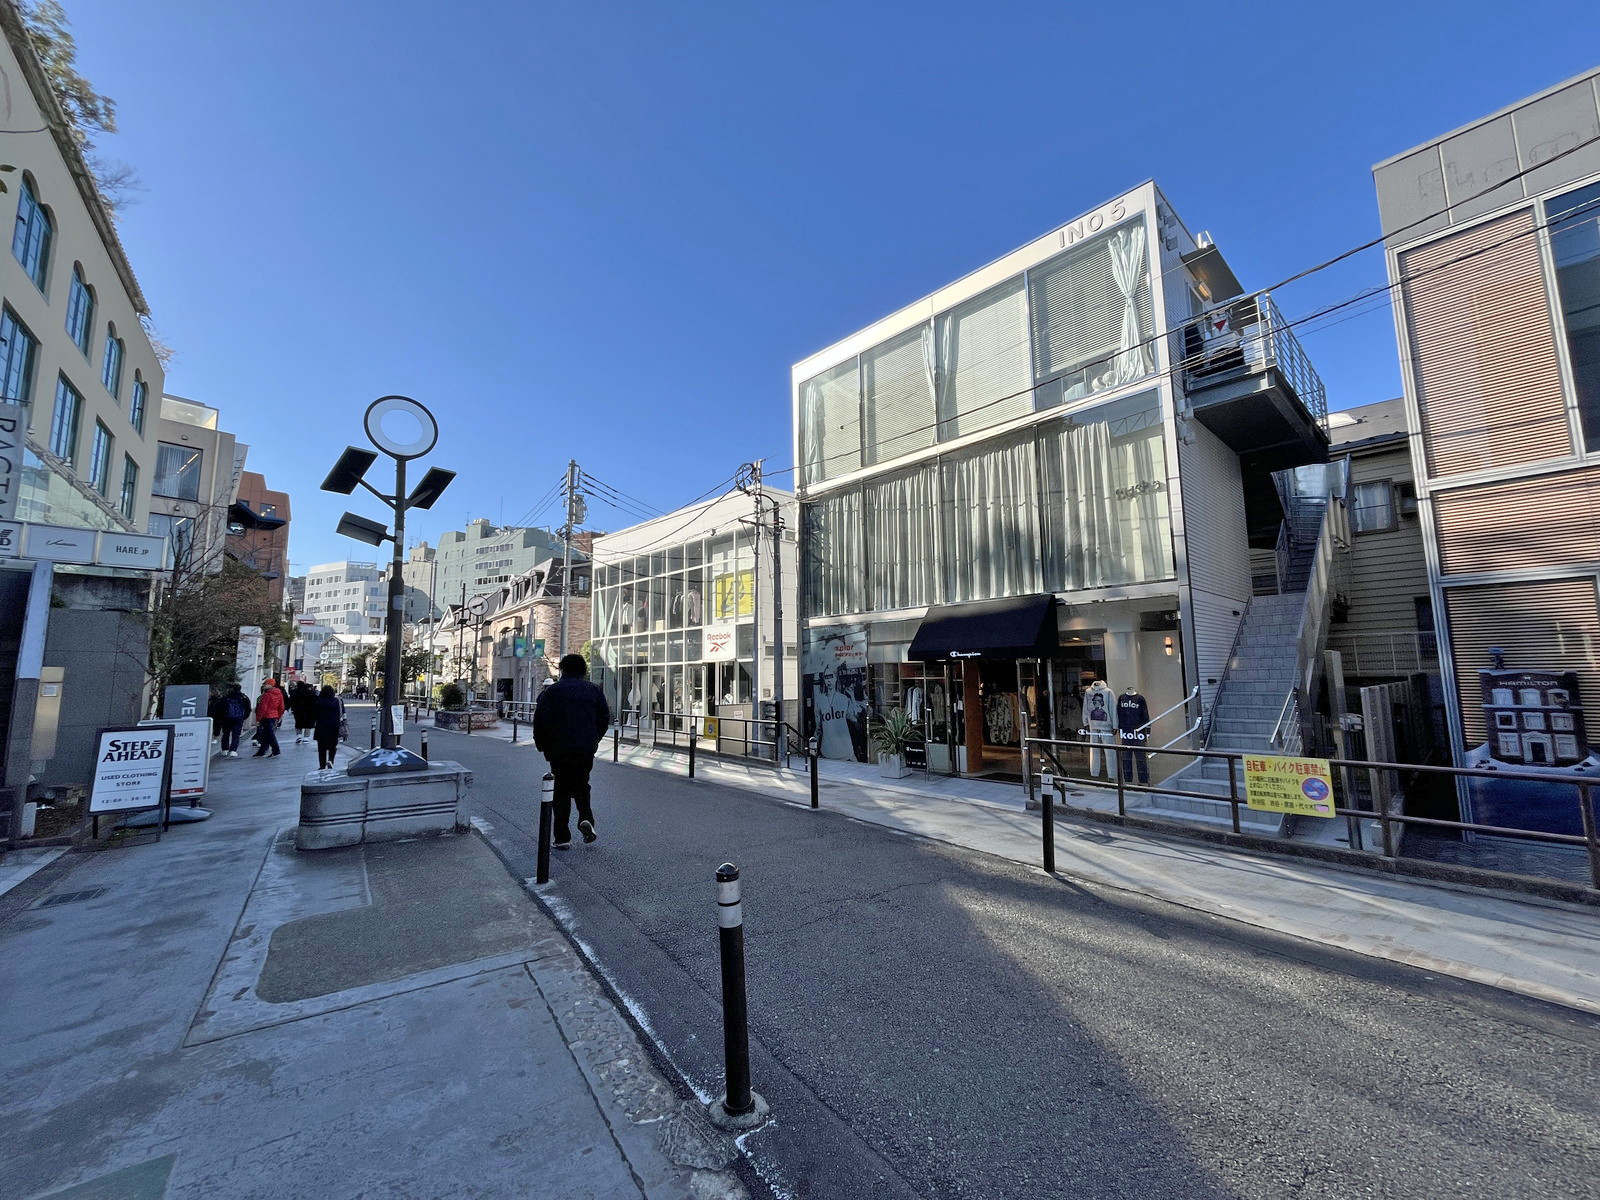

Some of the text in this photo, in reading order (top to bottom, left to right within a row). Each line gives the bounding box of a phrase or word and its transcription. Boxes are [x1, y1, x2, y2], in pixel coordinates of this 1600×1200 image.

[1059, 199, 1126, 248] INO 5
[0, 417, 17, 519] RAT
[116, 545, 139, 555] HARE
[707, 632, 731, 641] Reebok
[181, 696, 197, 719] VE
[108, 739, 151, 752] STEP
[102, 750, 162, 762] AHEAD
[1246, 760, 1327, 777] 自転車・バイク駐車禁止
